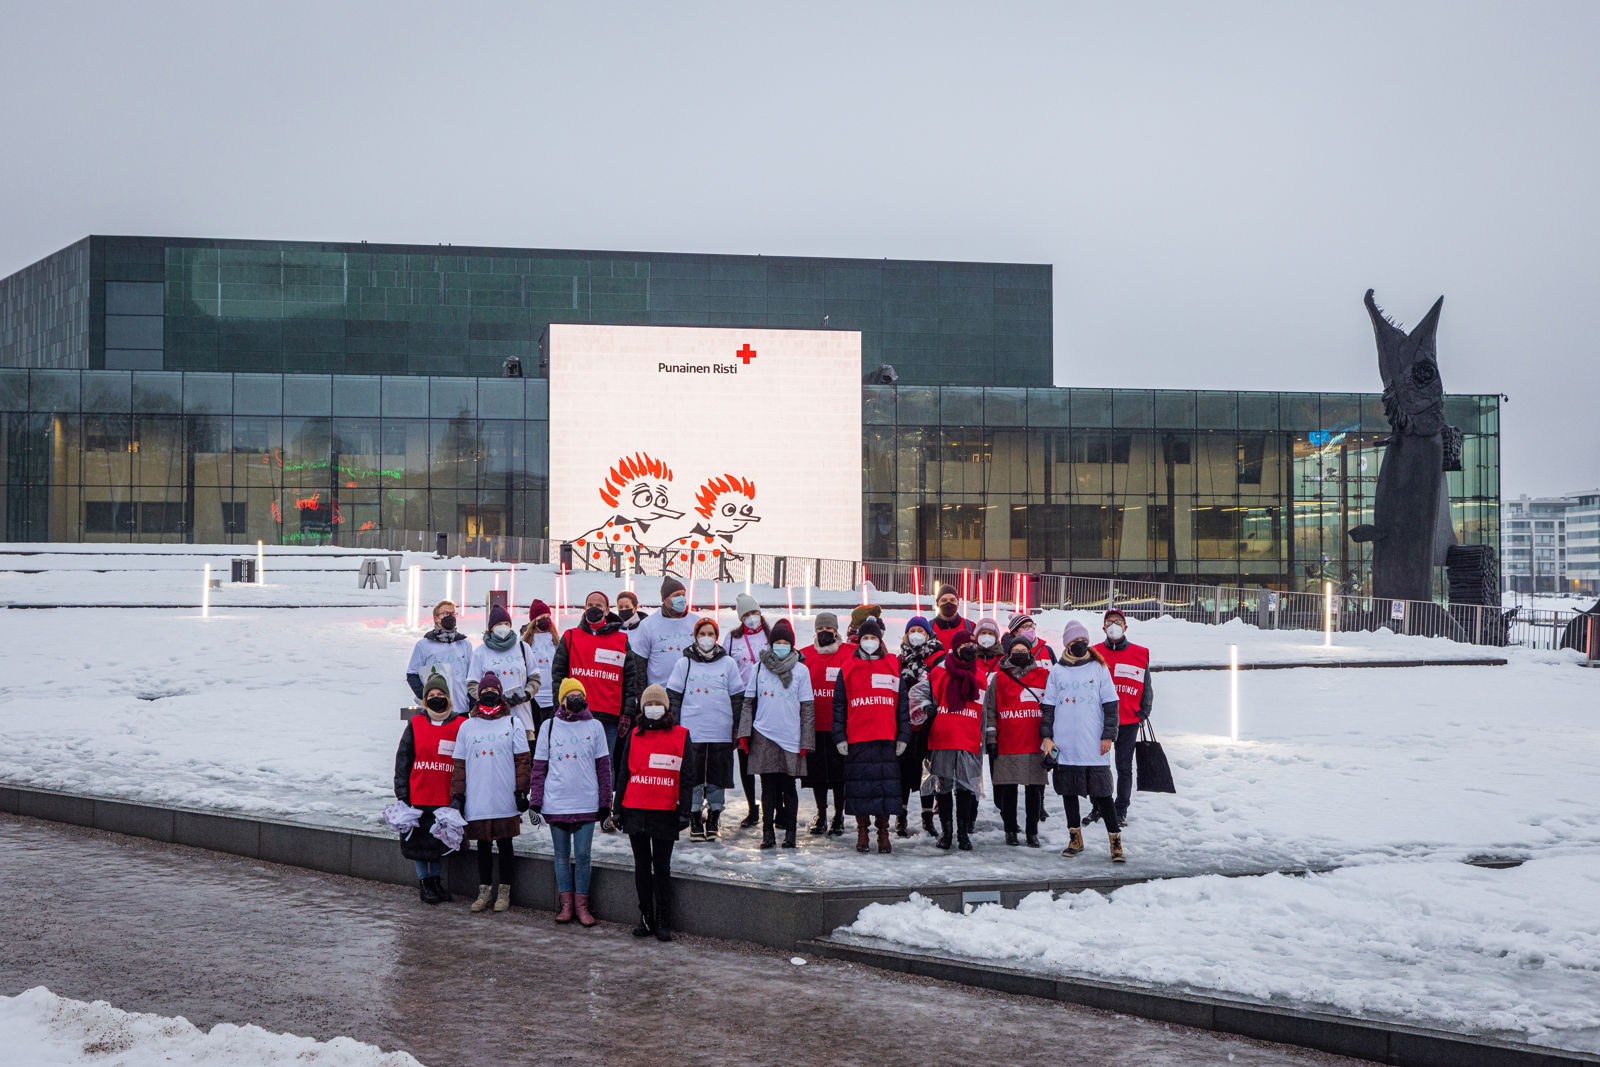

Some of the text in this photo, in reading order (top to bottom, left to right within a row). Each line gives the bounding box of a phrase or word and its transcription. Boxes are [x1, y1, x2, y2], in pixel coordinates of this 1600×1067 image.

[658, 362, 738, 374] Punainen Risti
[571, 667, 619, 681] VAPAAEHTOINEN
